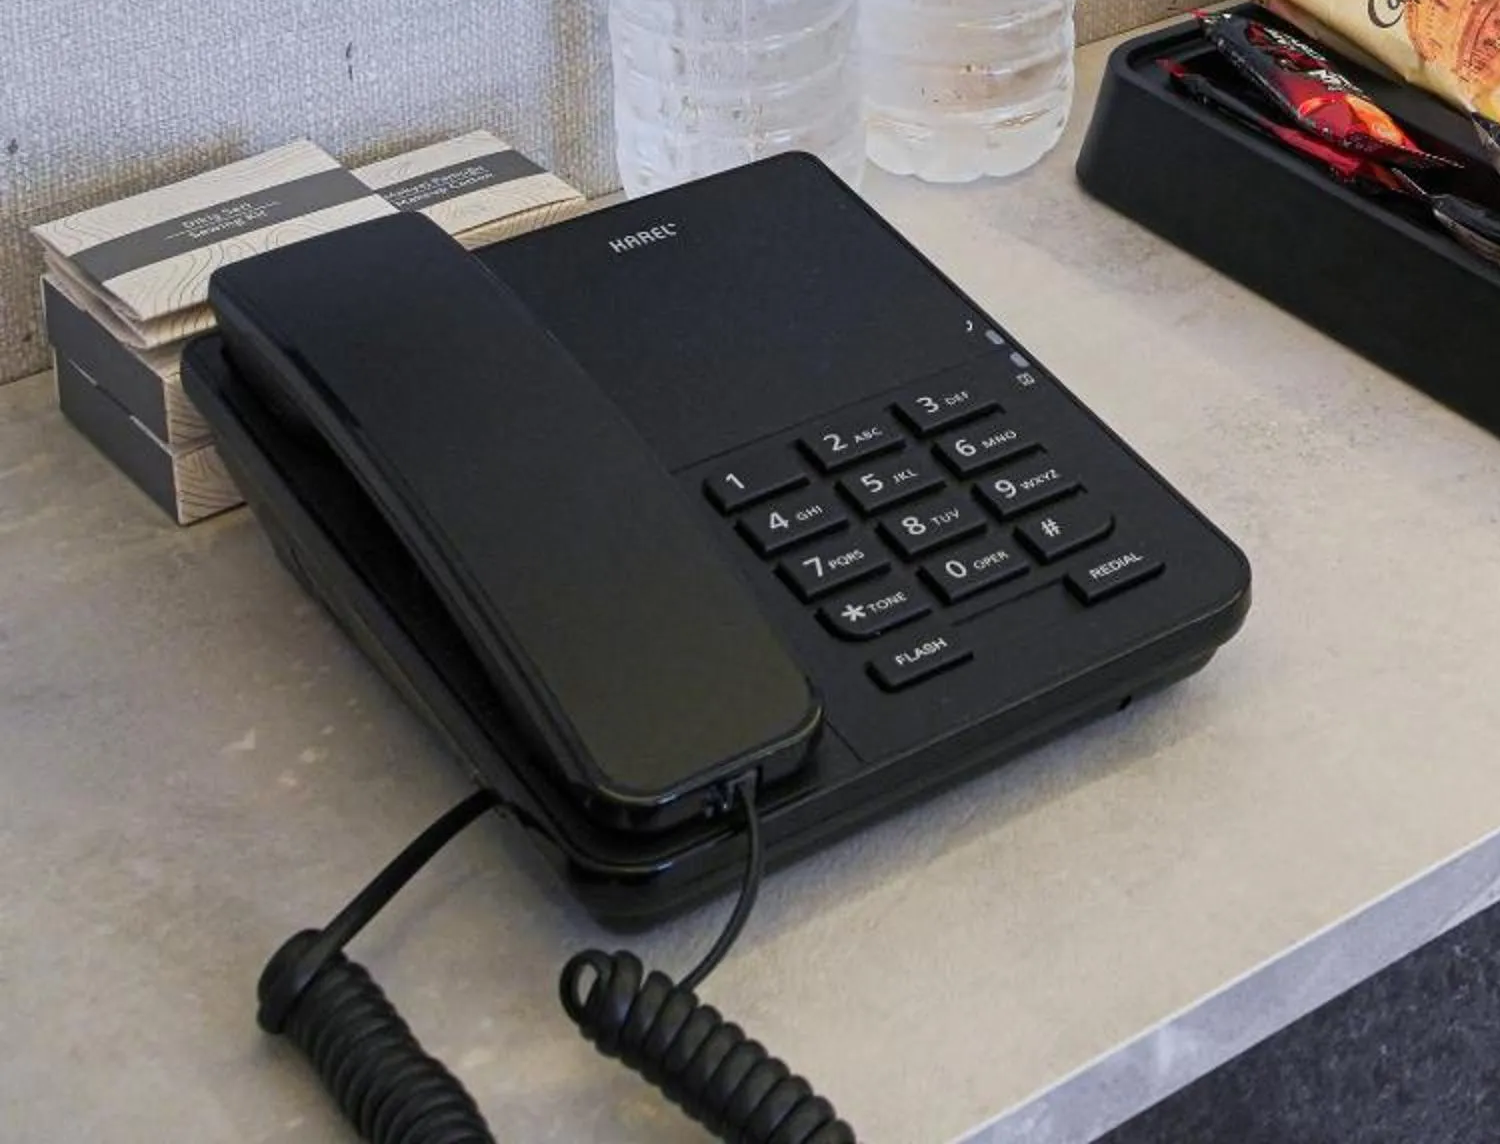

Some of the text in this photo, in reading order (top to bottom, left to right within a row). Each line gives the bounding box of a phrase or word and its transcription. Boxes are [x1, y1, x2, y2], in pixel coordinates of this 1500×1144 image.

[915, 396, 940, 414] 3
[823, 427, 883, 453] 2 ABC
[955, 428, 1017, 457] 6 MNO
[725, 472, 746, 491] 1
[860, 472, 884, 493] 5
[995, 479, 1017, 499] 9
[768, 504, 824, 531] 4 GHI
[902, 508, 961, 536] 8 TUV
[803, 555, 824, 577] 7
[945, 559, 969, 579] 0
[1088, 551, 1144, 579] REDIAL
[867, 591, 908, 614] TONE
[895, 636, 949, 666] FLASH
